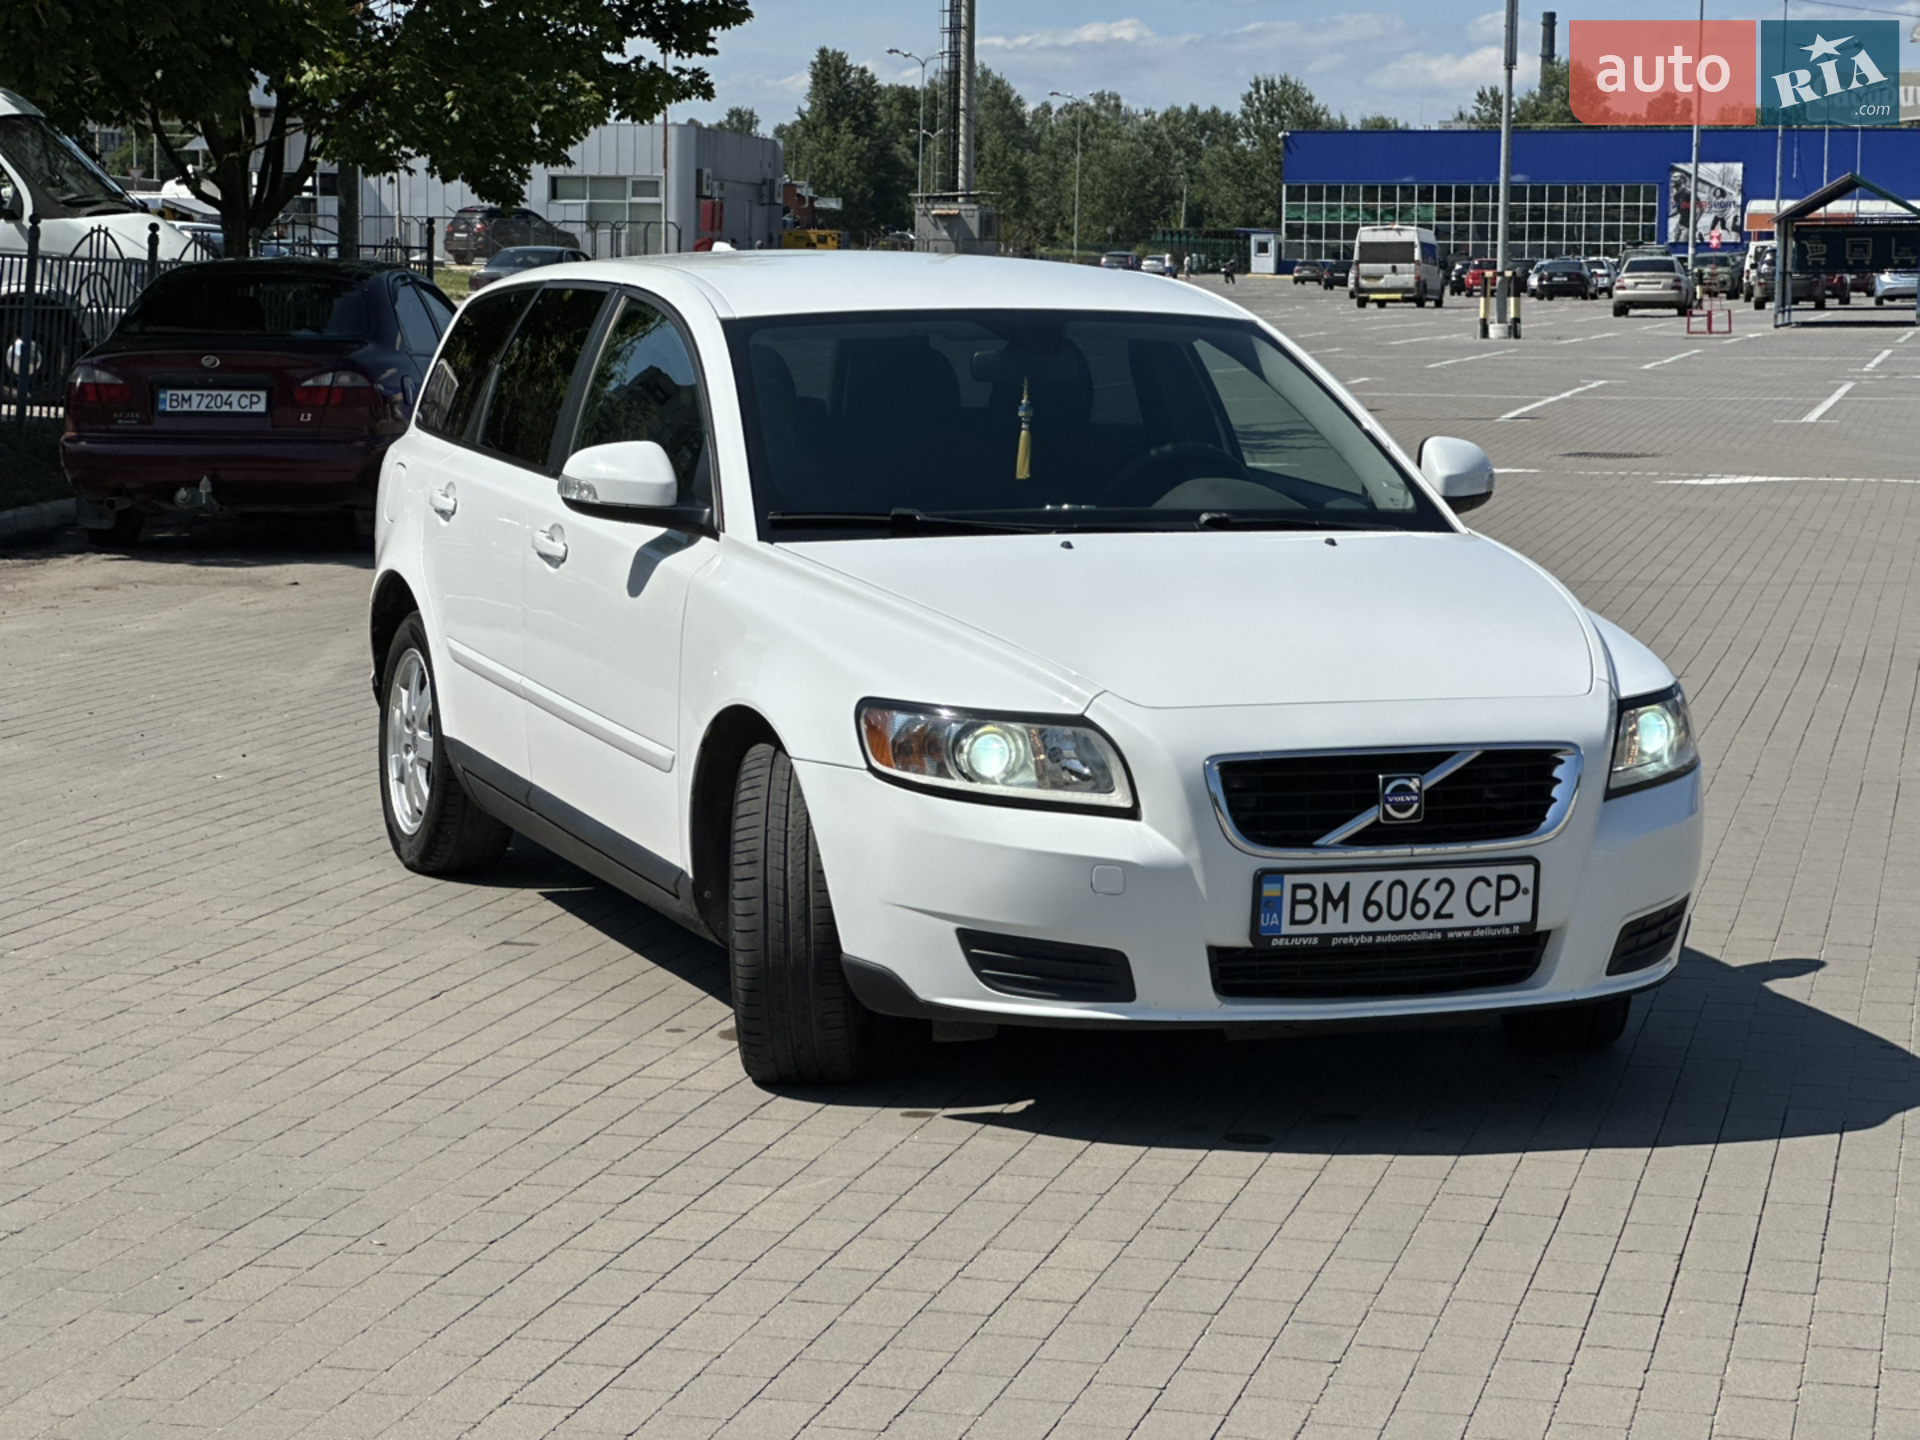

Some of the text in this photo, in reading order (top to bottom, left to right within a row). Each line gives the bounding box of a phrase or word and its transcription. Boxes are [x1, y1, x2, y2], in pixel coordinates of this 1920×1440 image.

[168, 393, 192, 409] BM
[196, 393, 233, 409] 7204
[237, 393, 261, 409] CP
[1289, 873, 1521, 926] BM 6062 CP
[1260, 913, 1280, 926] UA
[1271, 925, 1520, 946] DELIUVIS prekyba automobiliais www.deliuvis.lt
